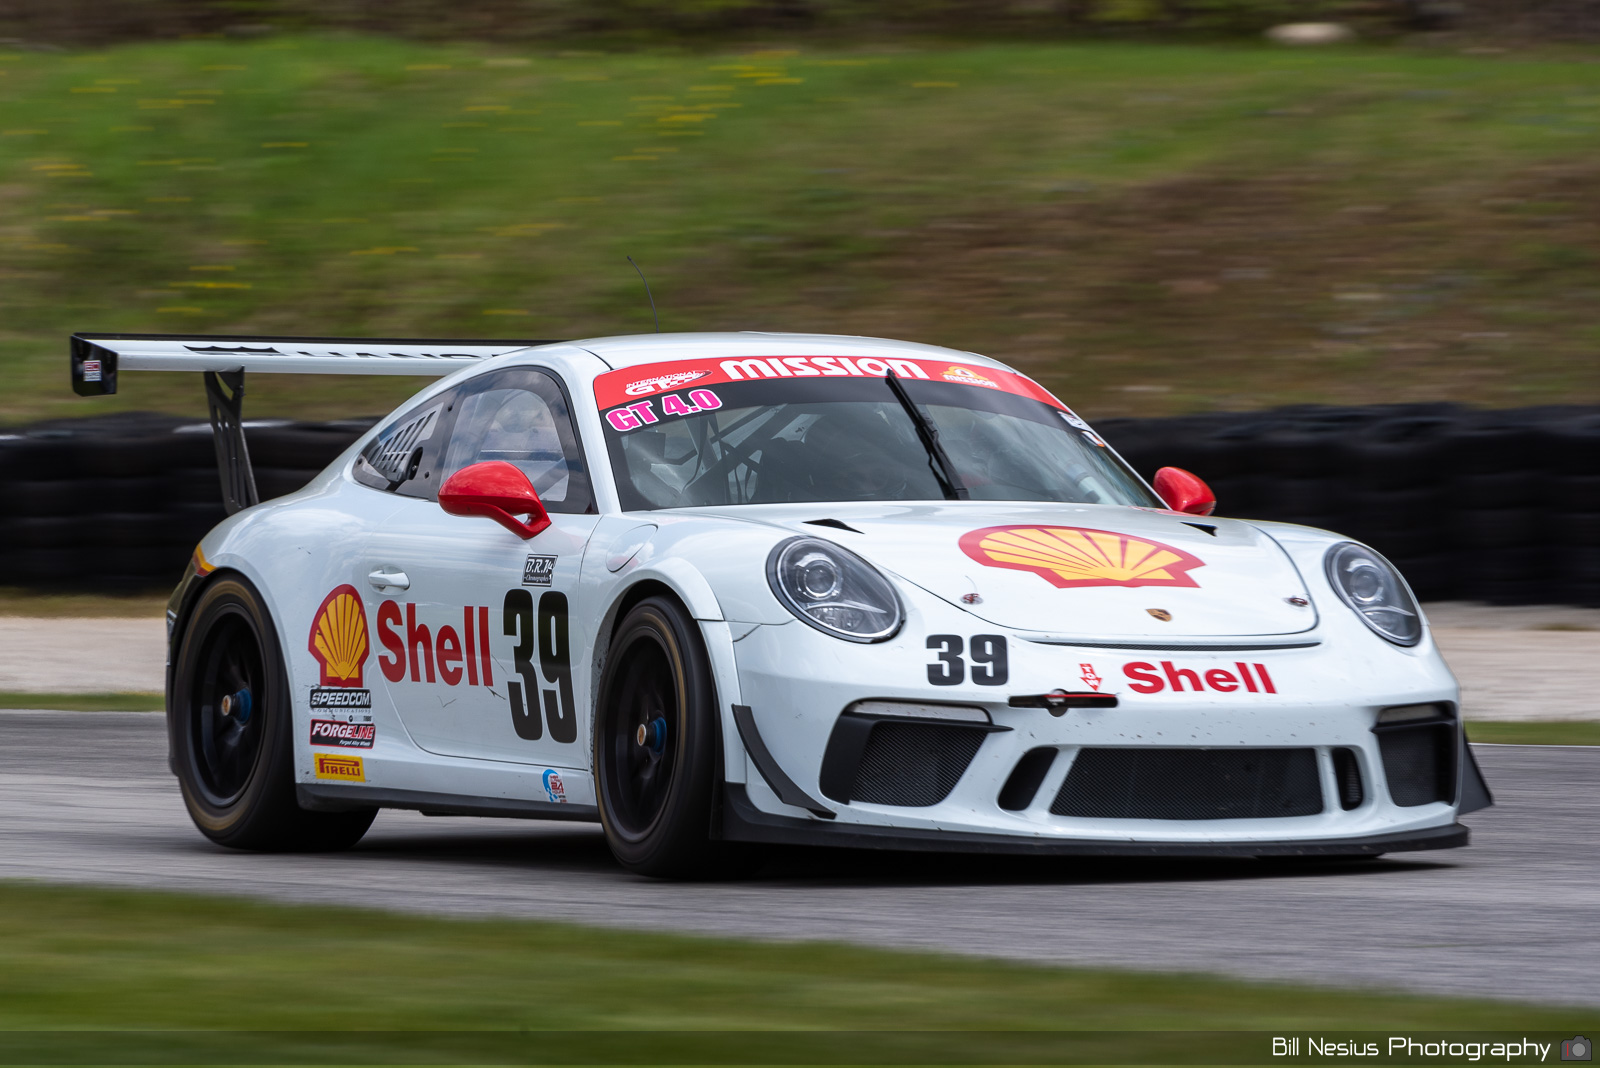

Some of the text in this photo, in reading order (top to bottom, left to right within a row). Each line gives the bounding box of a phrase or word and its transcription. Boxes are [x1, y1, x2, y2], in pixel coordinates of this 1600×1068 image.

[626, 370, 697, 389] INTERNATIONAL
[605, 389, 723, 431] GT 4.0
[376, 599, 494, 687] Shell
[503, 589, 578, 743] 39
[927, 634, 1009, 686] 39
[1081, 666, 1101, 687] TOW
[1122, 661, 1278, 694] Shell
[311, 692, 371, 706] SPEEDCOM
[312, 723, 374, 739] FORGELINE
[318, 758, 360, 776] PIRELLI
